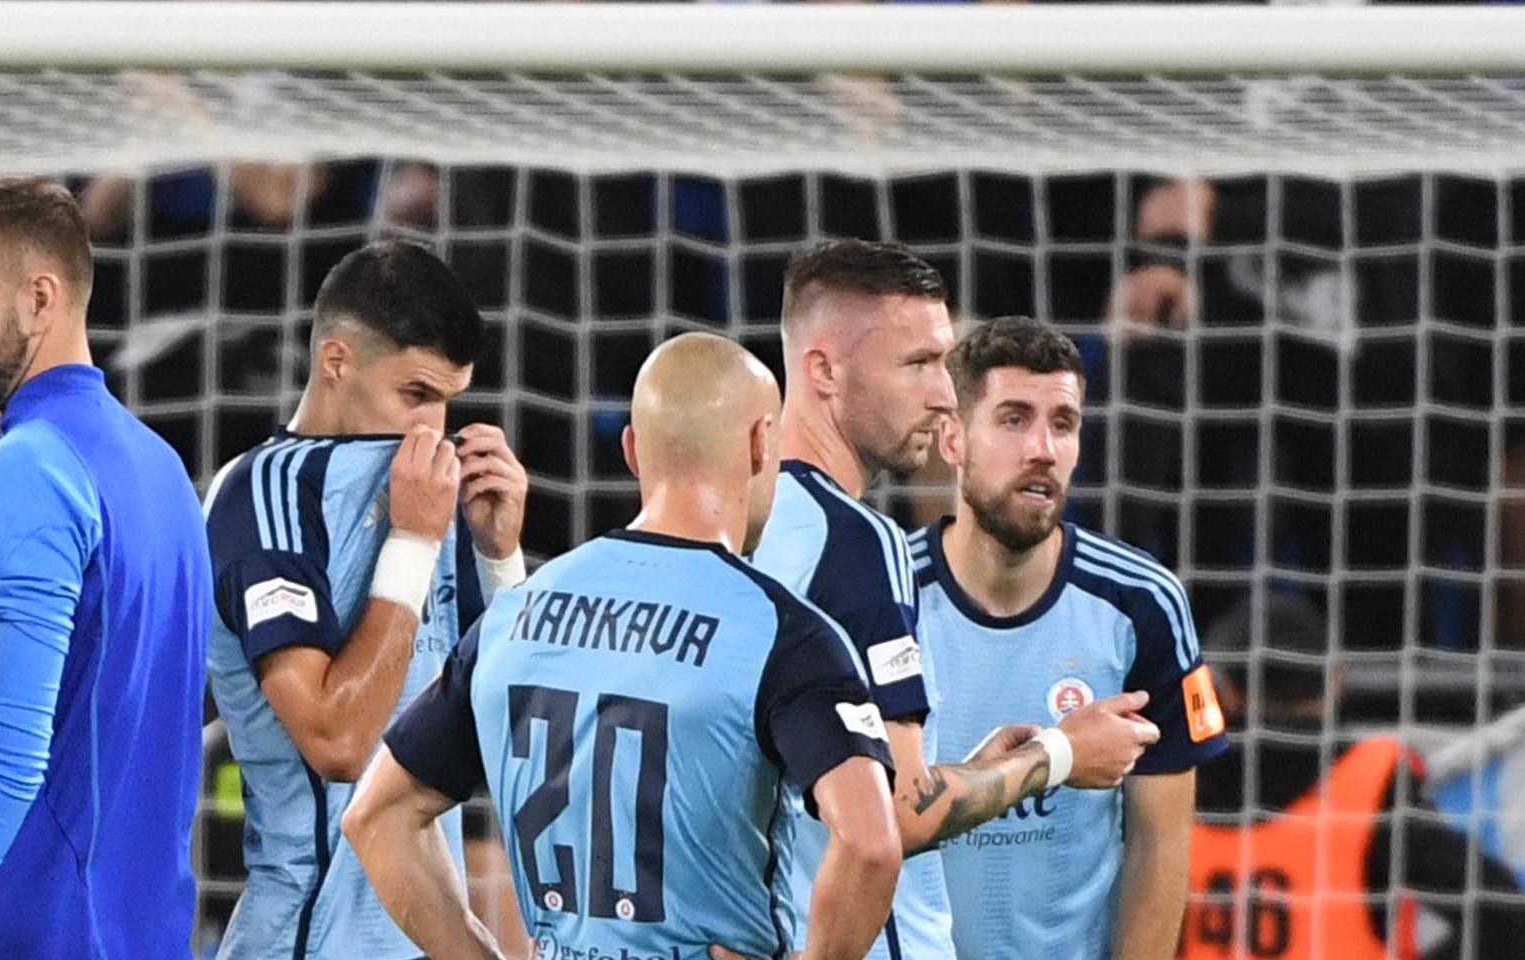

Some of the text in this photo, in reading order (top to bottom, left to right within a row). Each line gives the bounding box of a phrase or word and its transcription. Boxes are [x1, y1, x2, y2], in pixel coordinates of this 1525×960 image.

[509, 590, 720, 668] KANKAVA
[508, 684, 669, 923] 20
[1176, 866, 1292, 960] 46
